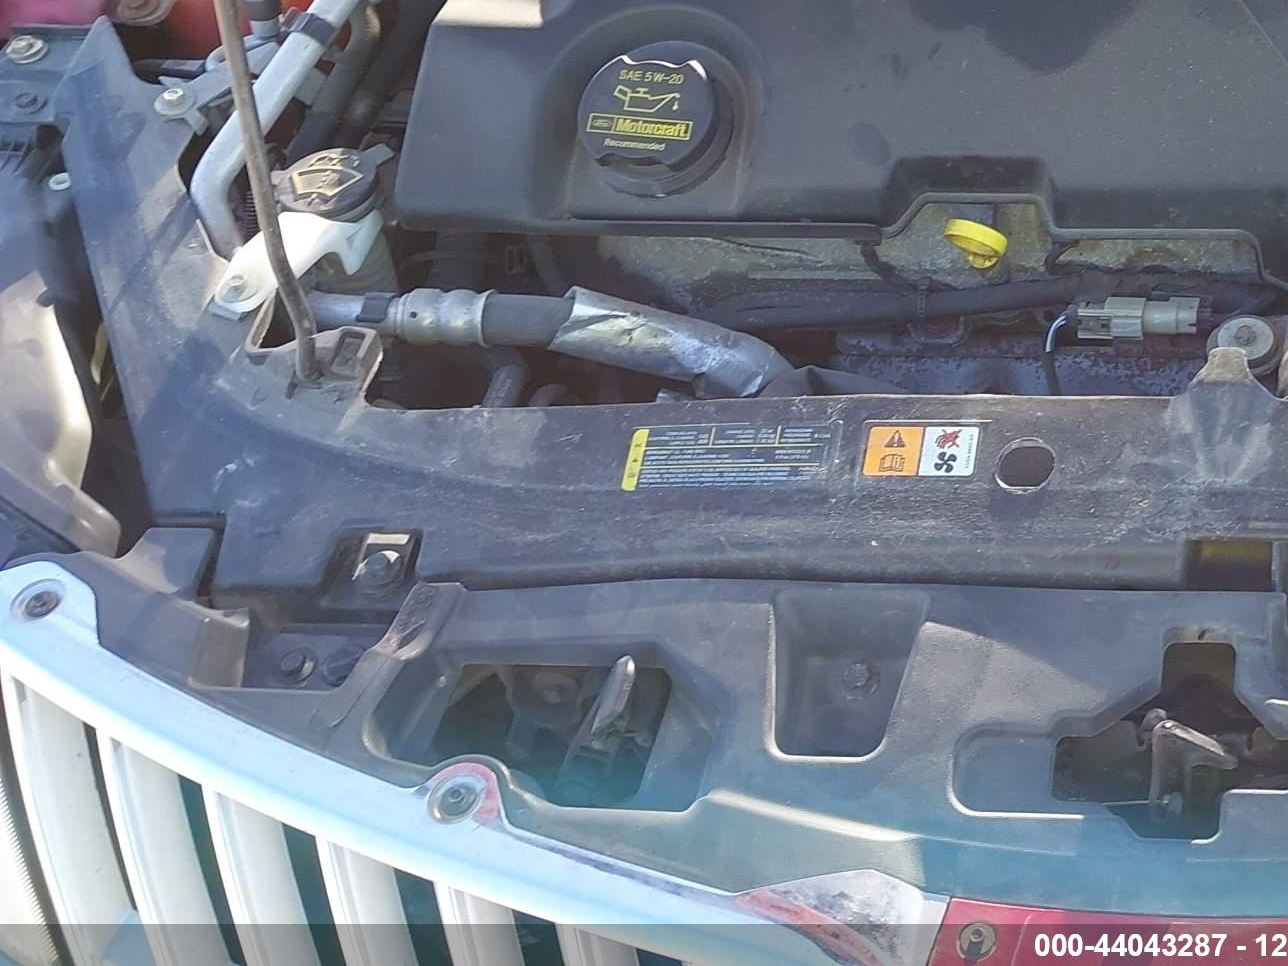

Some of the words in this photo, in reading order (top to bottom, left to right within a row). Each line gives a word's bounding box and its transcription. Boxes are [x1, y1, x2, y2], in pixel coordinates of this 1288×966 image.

[618, 70, 643, 81] SAE
[644, 70, 685, 85] 5W-20
[615, 117, 688, 137] Motorcraft
[604, 137, 667, 151] Recommended
